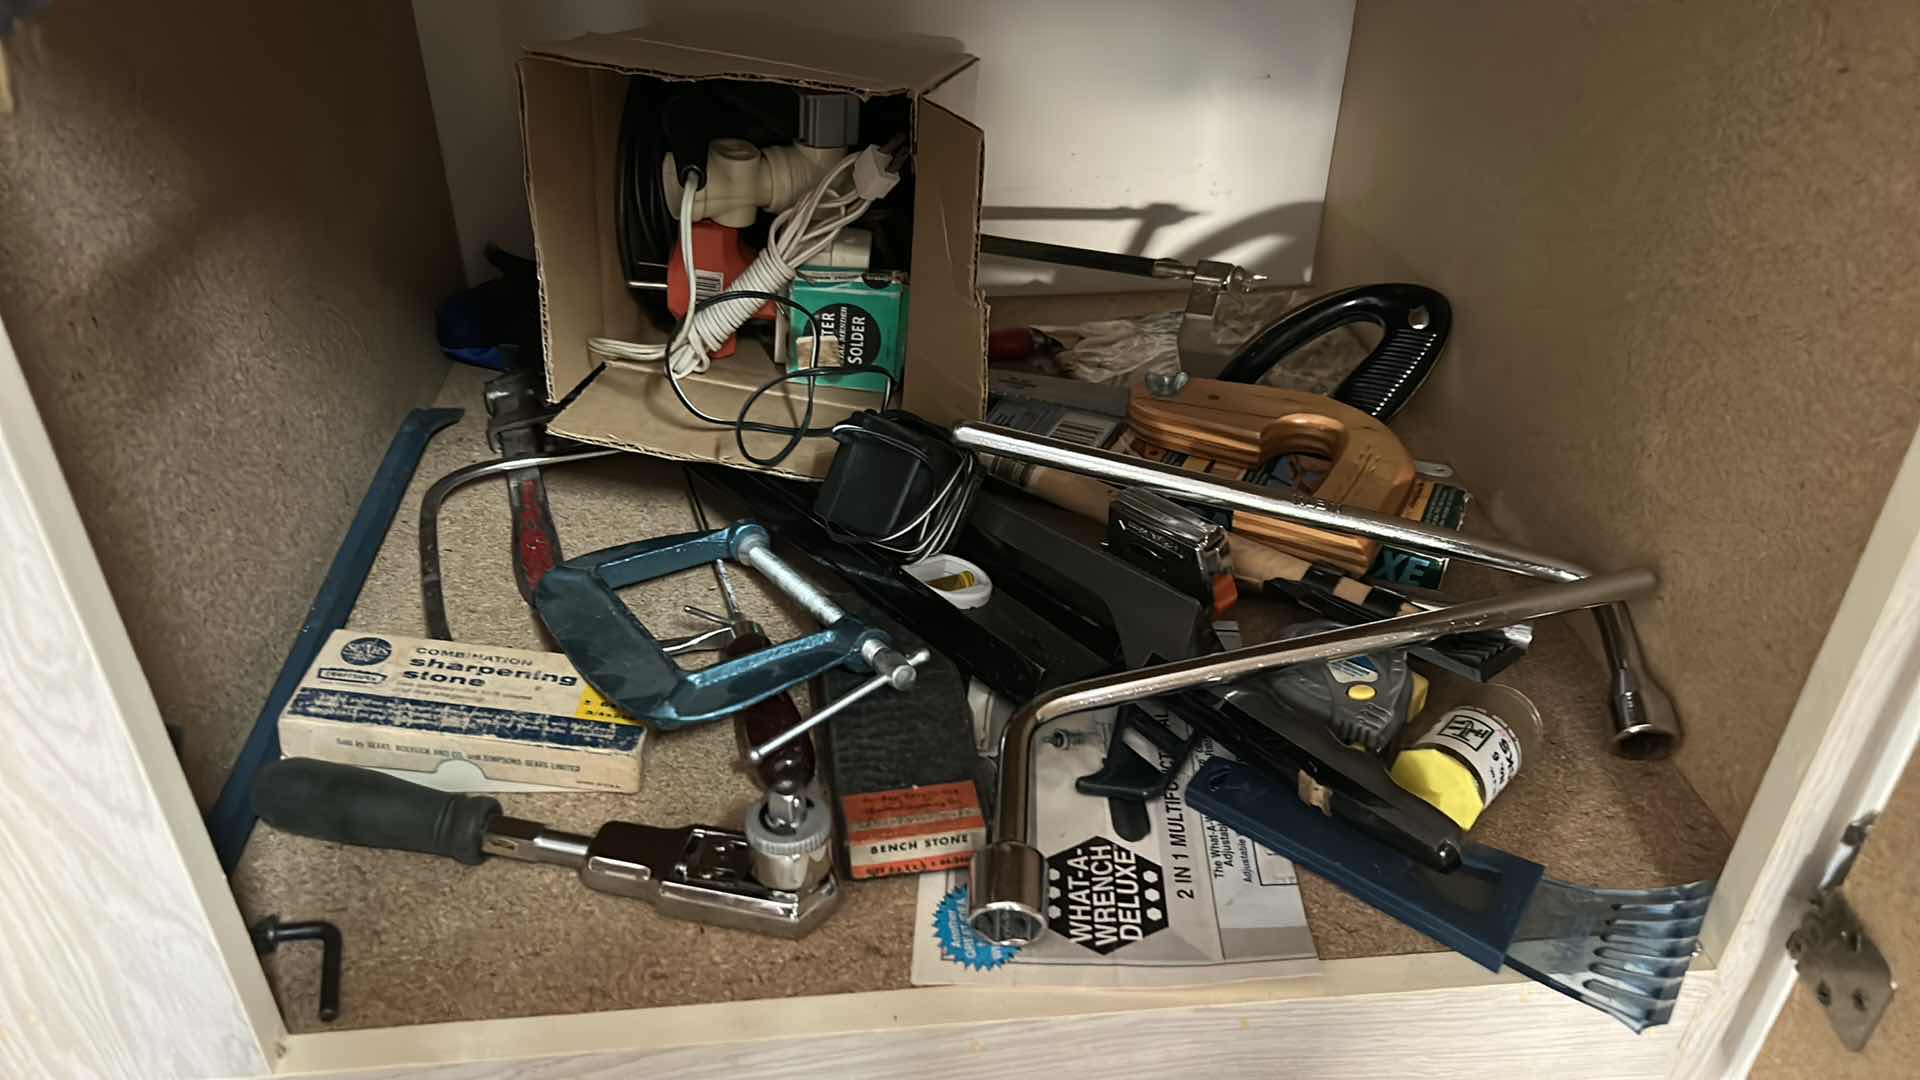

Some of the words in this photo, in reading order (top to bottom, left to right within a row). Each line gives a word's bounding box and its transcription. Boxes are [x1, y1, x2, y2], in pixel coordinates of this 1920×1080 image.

[821, 312, 836, 337] TER
[839, 306, 848, 342] MENDER
[847, 316, 866, 365] SOLDER
[1381, 549, 1431, 586] XE
[409, 657, 578, 687] sharpening
[415, 647, 534, 667] COMBINATION
[402, 670, 486, 688] stone
[870, 842, 918, 855] BENCH
[924, 834, 969, 848] STONE
[1204, 815, 1222, 858] What-A-
[1217, 824, 1235, 867] Adjustab
[1174, 867, 1192, 883] IN
[1213, 861, 1225, 878] The
[1238, 838, 1253, 883] Adjustable
[1067, 848, 1093, 945] WHAT-A-
[1089, 845, 1114, 947] WRENCH
[1112, 848, 1145, 941] DELUXE
[1177, 889, 1195, 900] 2
